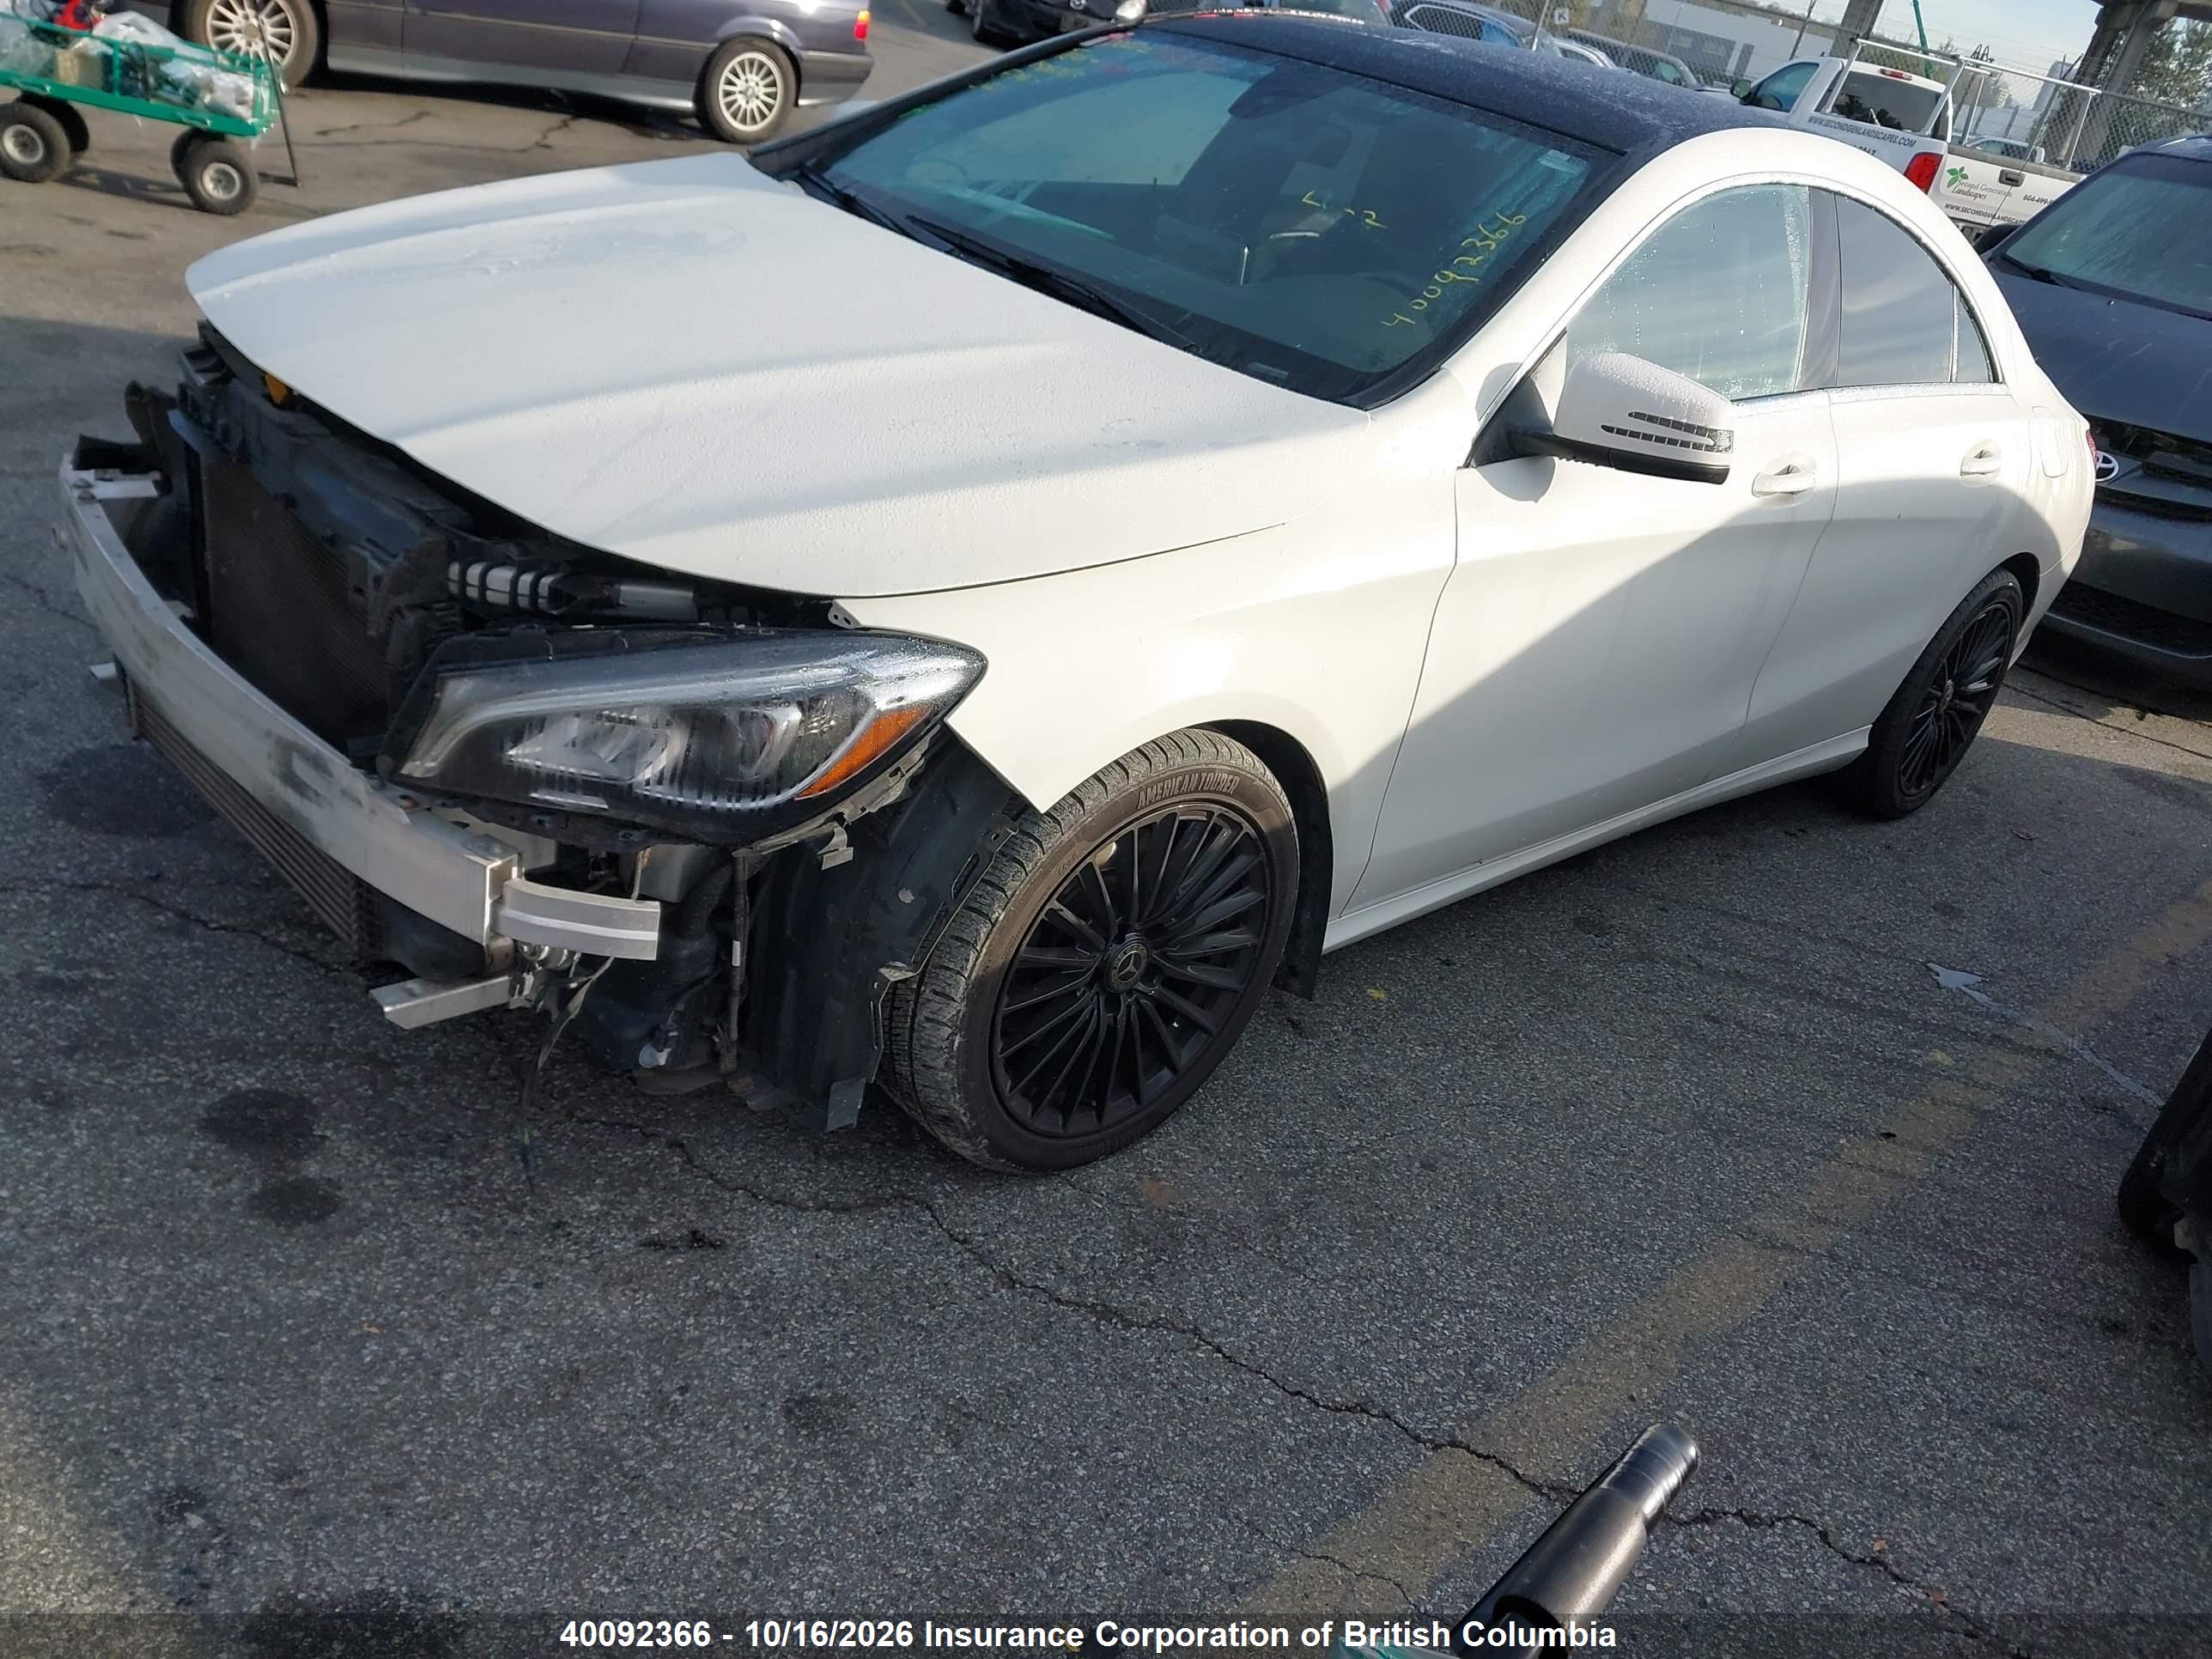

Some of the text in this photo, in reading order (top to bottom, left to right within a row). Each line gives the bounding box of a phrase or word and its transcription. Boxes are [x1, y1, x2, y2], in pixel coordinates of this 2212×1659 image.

[1951, 185, 1988, 201] Landscapes
[1958, 179, 2013, 198] Second Generation
[1380, 211, 1527, 326] 40092366
[1136, 771, 1241, 810] AMERICAN TOURER
